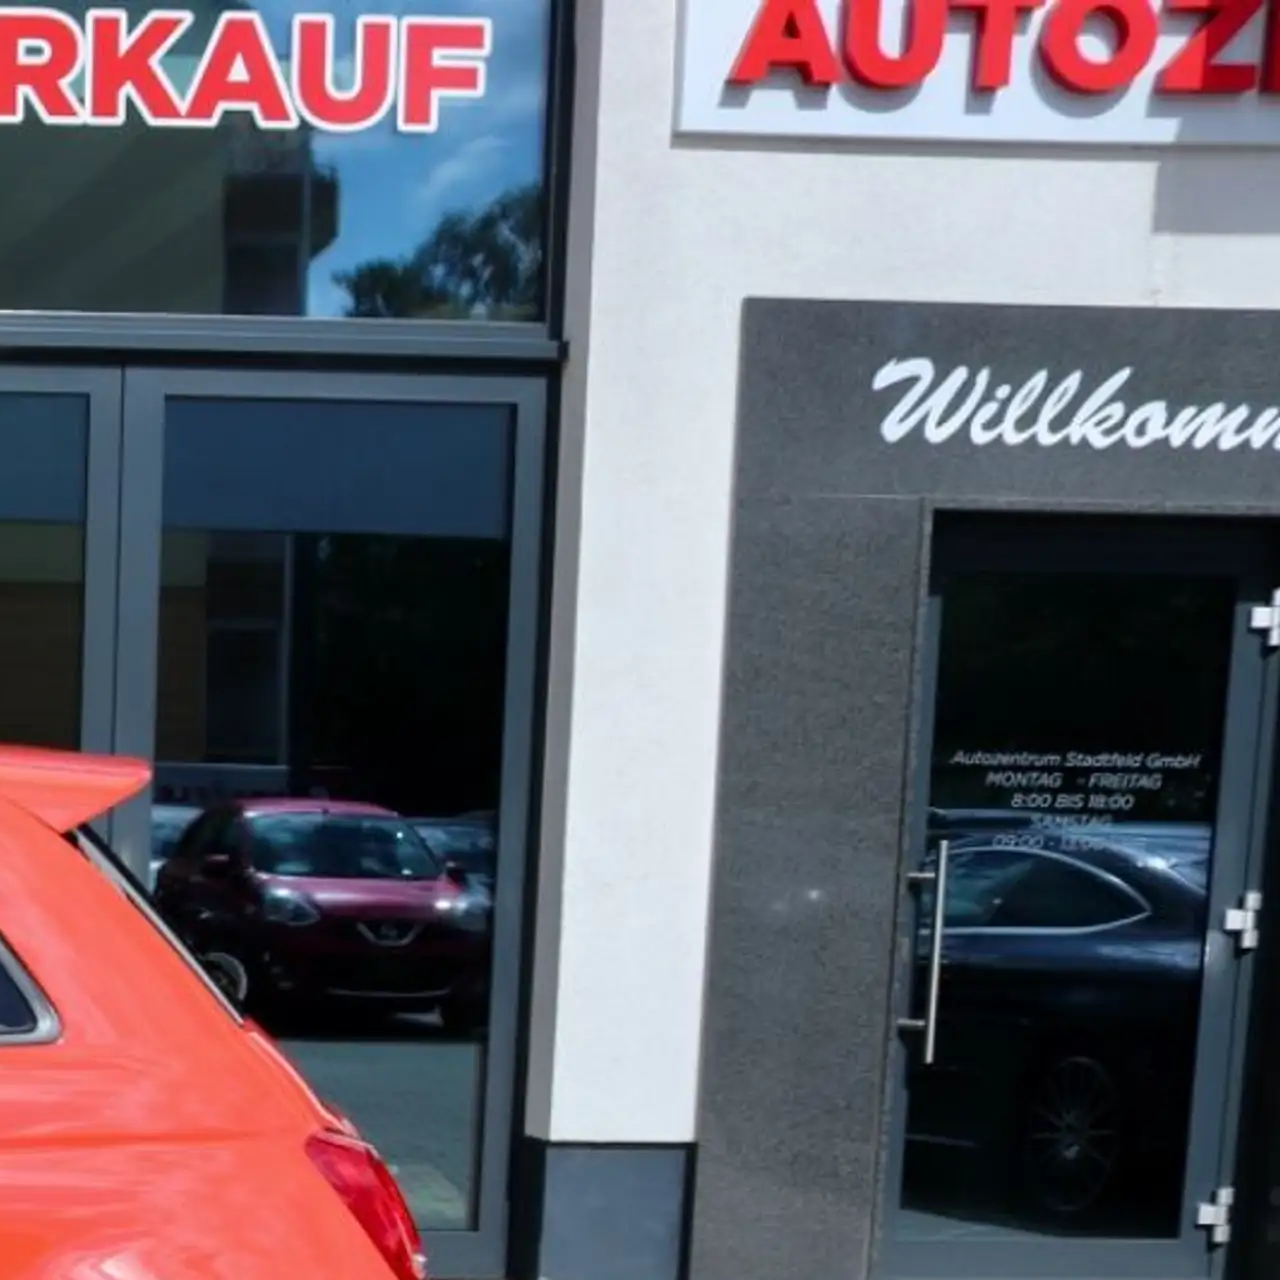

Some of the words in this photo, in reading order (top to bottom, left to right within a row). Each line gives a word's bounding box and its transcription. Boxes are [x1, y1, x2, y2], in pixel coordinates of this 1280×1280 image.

[726, 0, 1280, 95] AUTOZ
[985, 770, 1064, 788] MONTAG
[1087, 771, 1164, 790] FREITAG
[1011, 793, 1052, 808] 8:00
[1054, 793, 1085, 809] BIS
